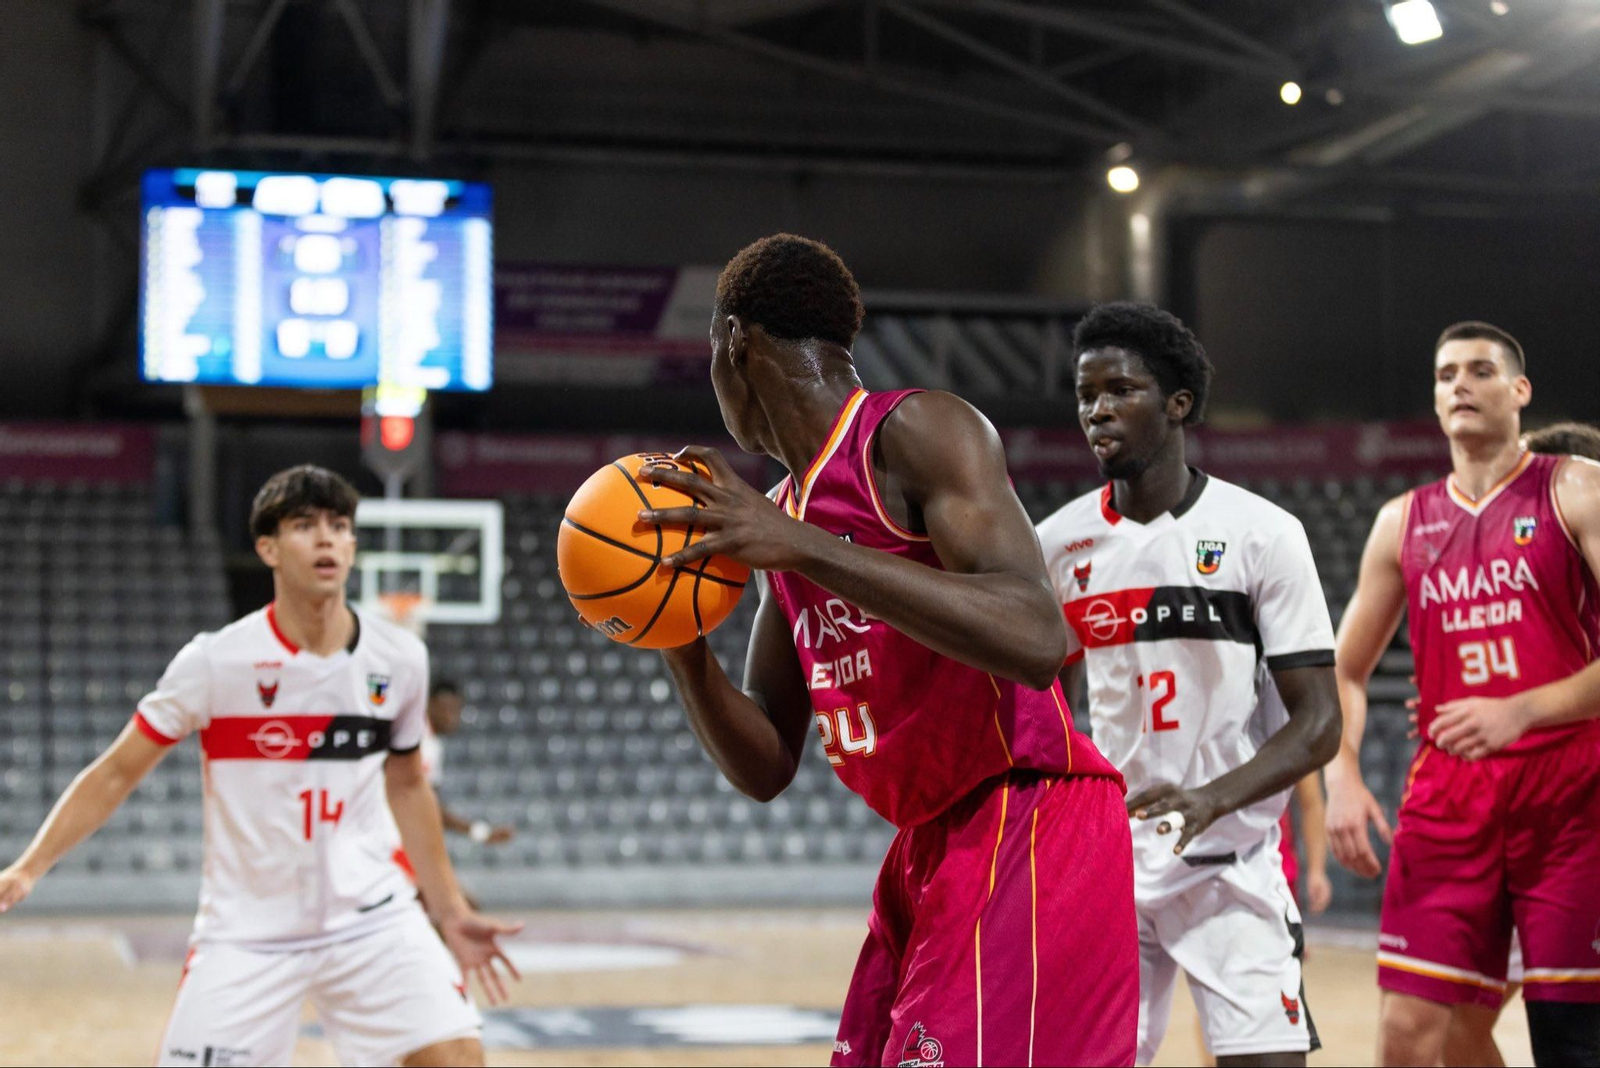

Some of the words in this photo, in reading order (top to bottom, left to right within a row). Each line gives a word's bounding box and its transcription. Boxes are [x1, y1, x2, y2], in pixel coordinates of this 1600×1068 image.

[1065, 538, 1094, 552] vive
[1198, 541, 1224, 551] LIGA
[1420, 556, 1539, 610] AMARA
[1130, 605, 1222, 625] OPEL
[1441, 598, 1523, 634] LLEIDA
[1457, 635, 1521, 686] 34
[815, 701, 878, 767] 24
[299, 788, 345, 842] 14
